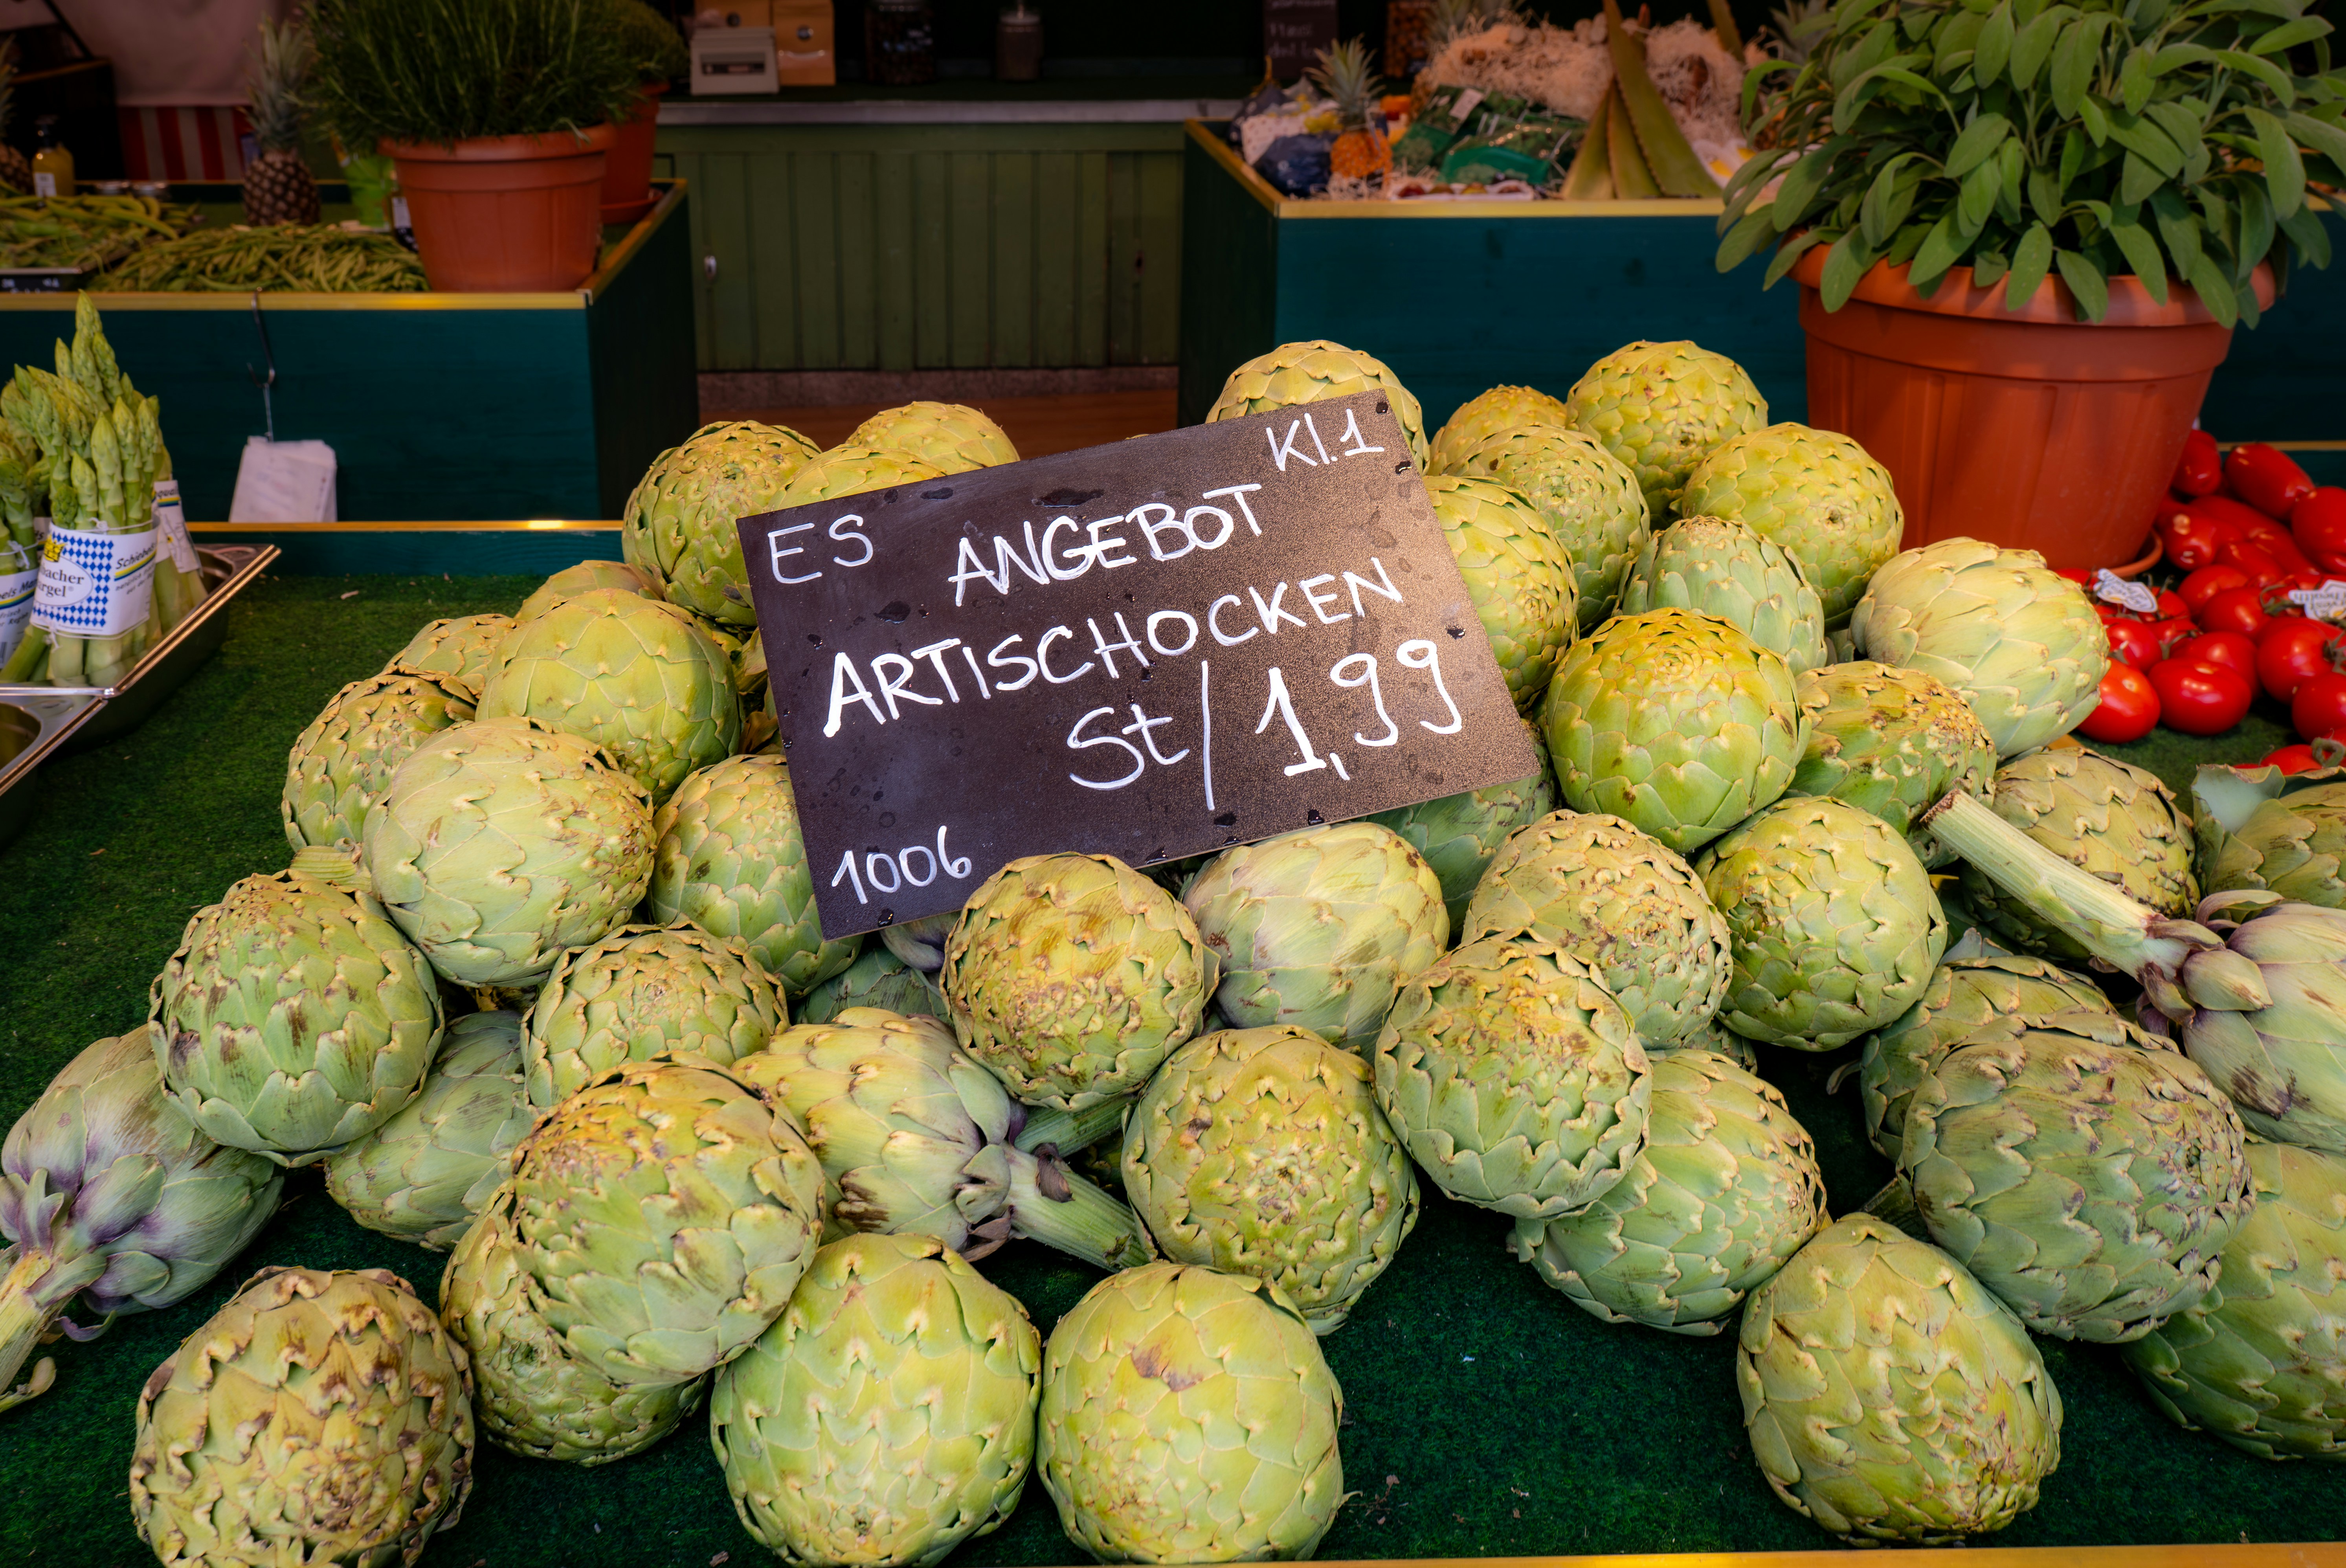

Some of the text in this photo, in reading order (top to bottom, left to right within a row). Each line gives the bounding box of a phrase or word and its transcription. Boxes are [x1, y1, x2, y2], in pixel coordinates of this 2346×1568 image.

[1266, 408, 1385, 472] Kl.1
[767, 514, 874, 584] ES
[947, 483, 1263, 607] ANGEBOT
[822, 556, 1404, 738] ARTISCHOCKEN
[1255, 637, 1463, 781] 1,99
[832, 825, 972, 904] 1006
